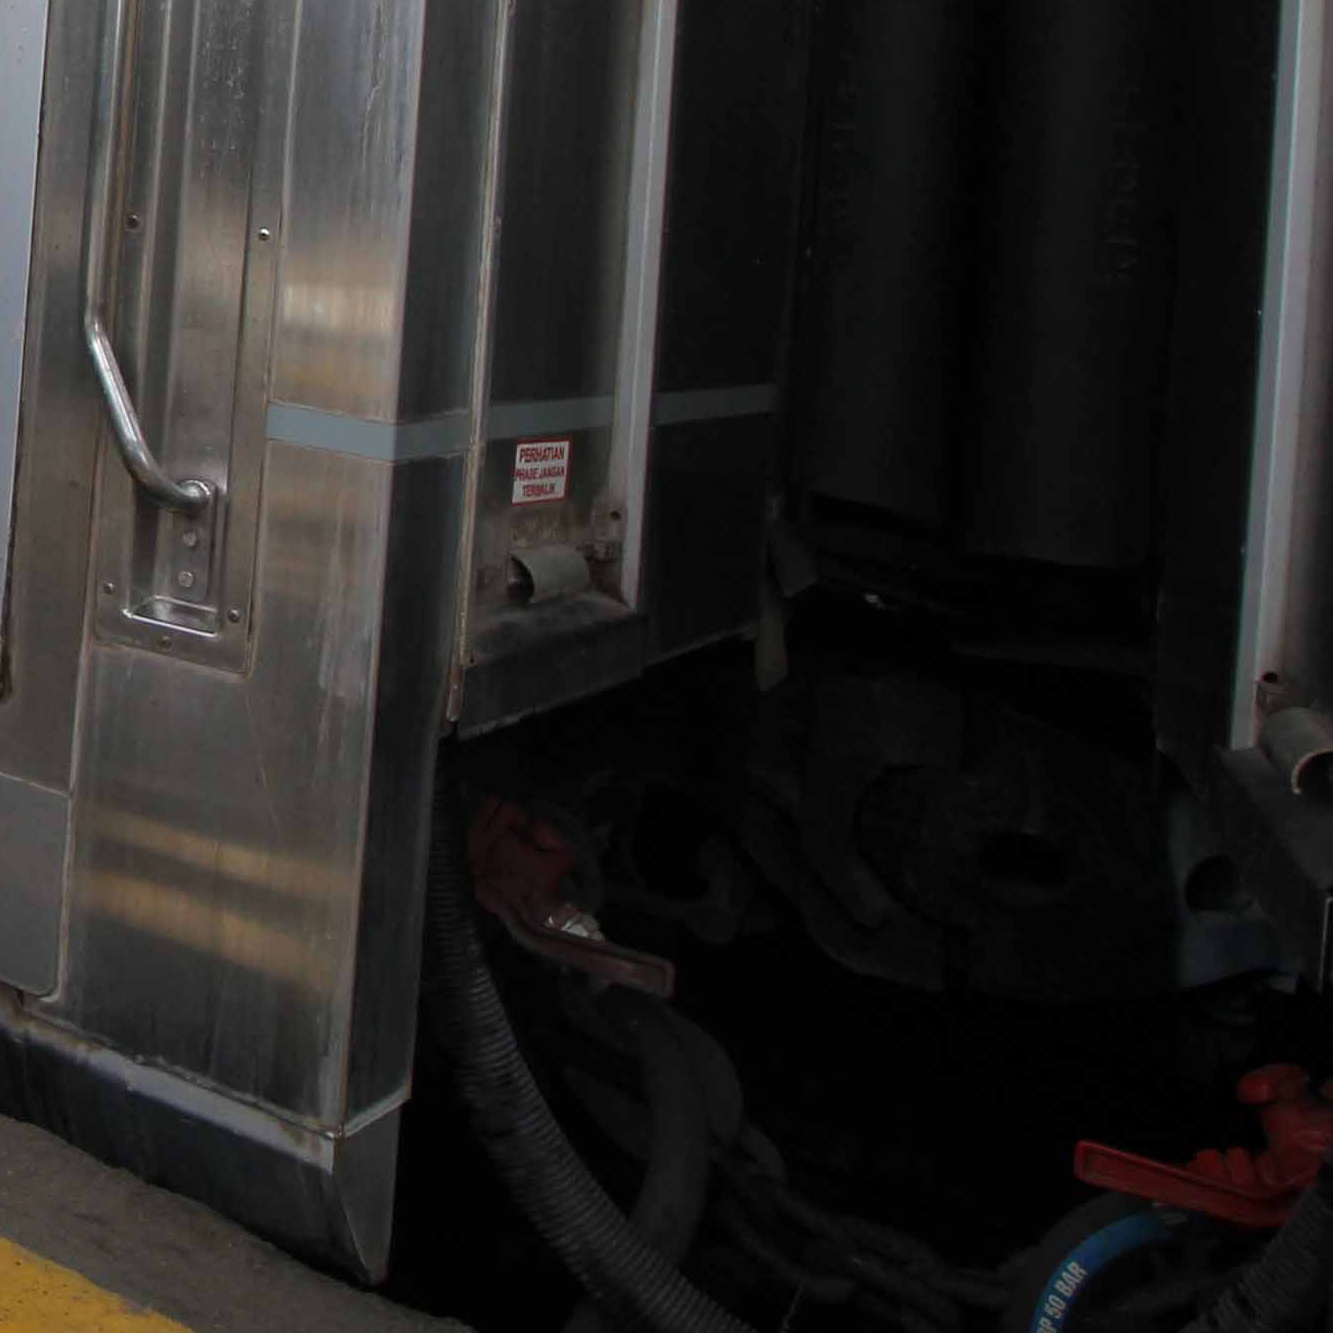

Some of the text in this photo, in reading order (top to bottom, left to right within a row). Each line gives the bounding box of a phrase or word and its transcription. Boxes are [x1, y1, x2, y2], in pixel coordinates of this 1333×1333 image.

[519, 447, 565, 463] PERHATIAN
[1055, 1261, 1086, 1298] BAR
[1045, 1294, 1066, 1320] 50
